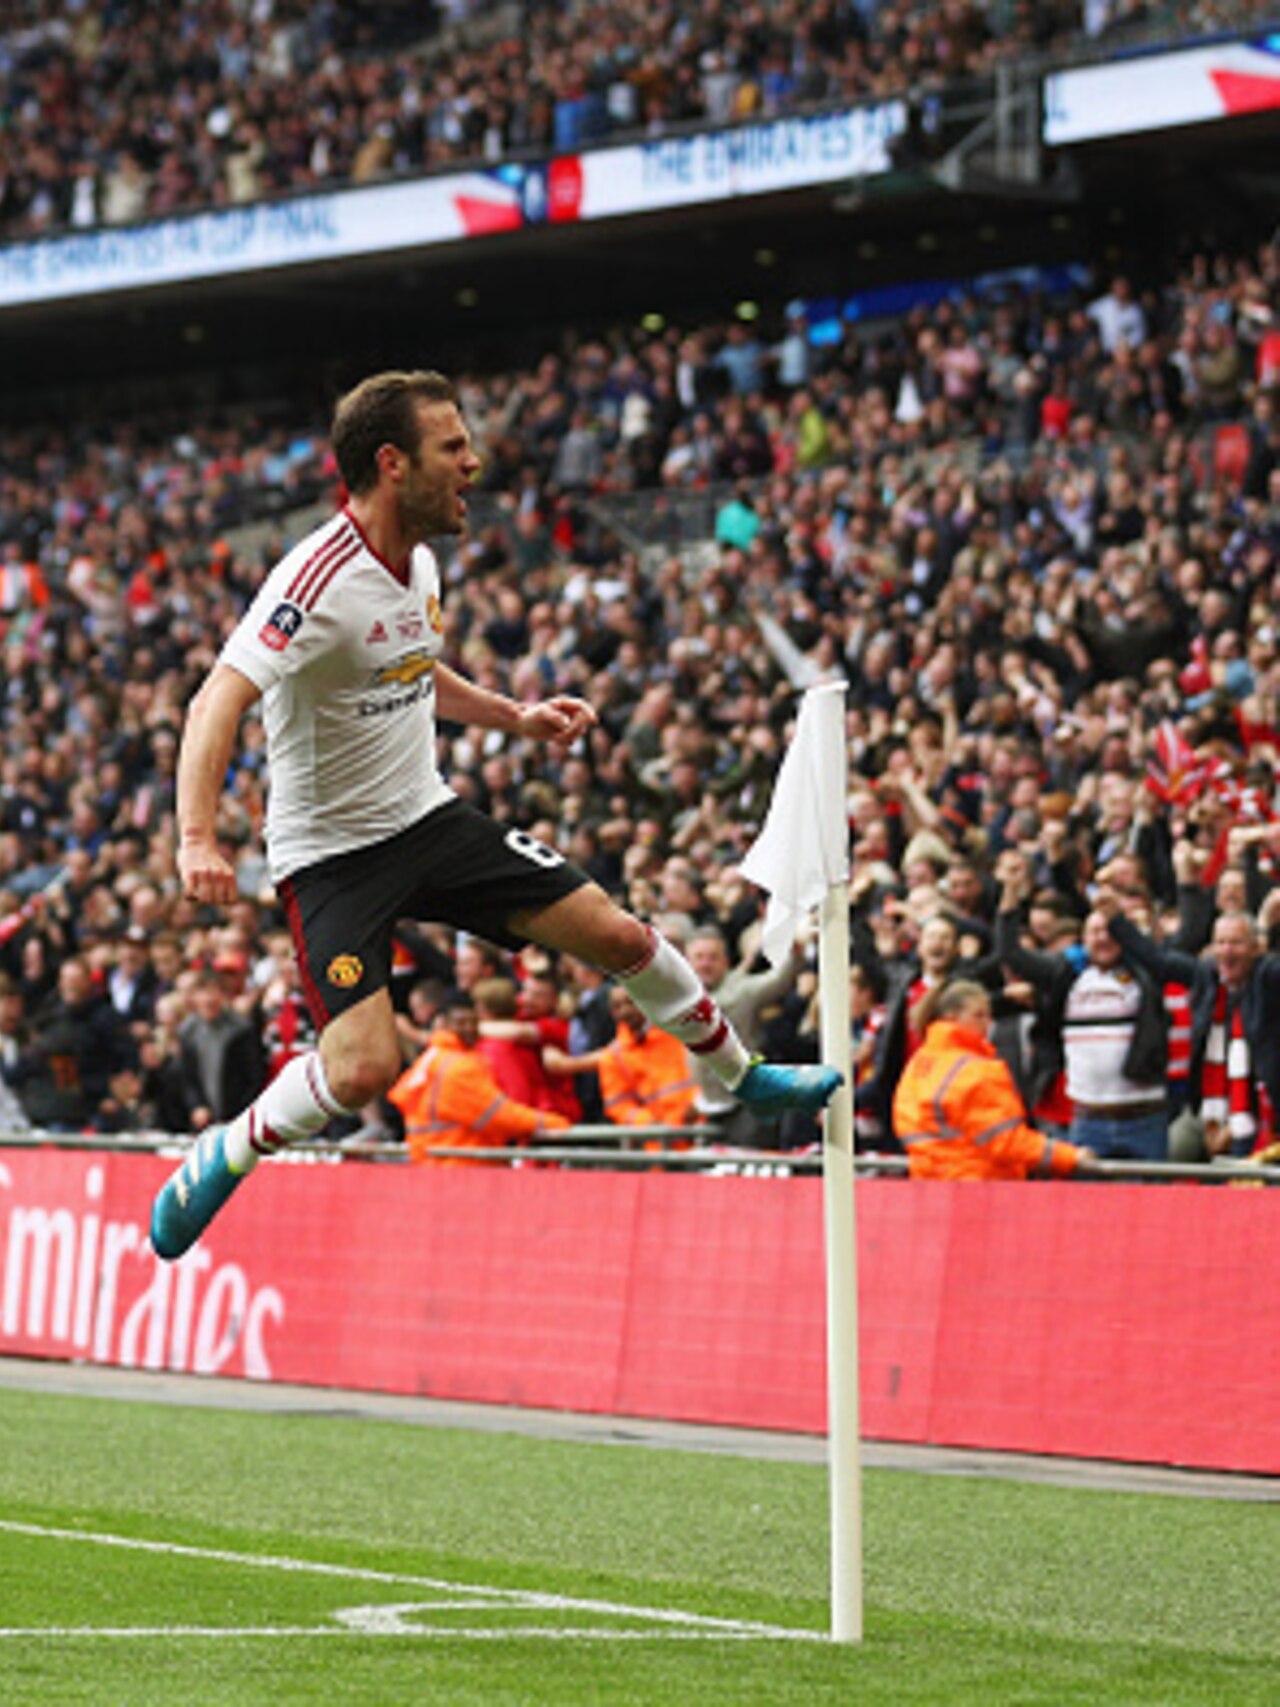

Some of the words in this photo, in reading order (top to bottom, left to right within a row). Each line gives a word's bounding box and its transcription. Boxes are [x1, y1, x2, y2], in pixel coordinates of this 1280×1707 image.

[641, 144, 693, 184] THE
[701, 114, 853, 180] EMIRATES
[504, 827, 567, 868] 8
